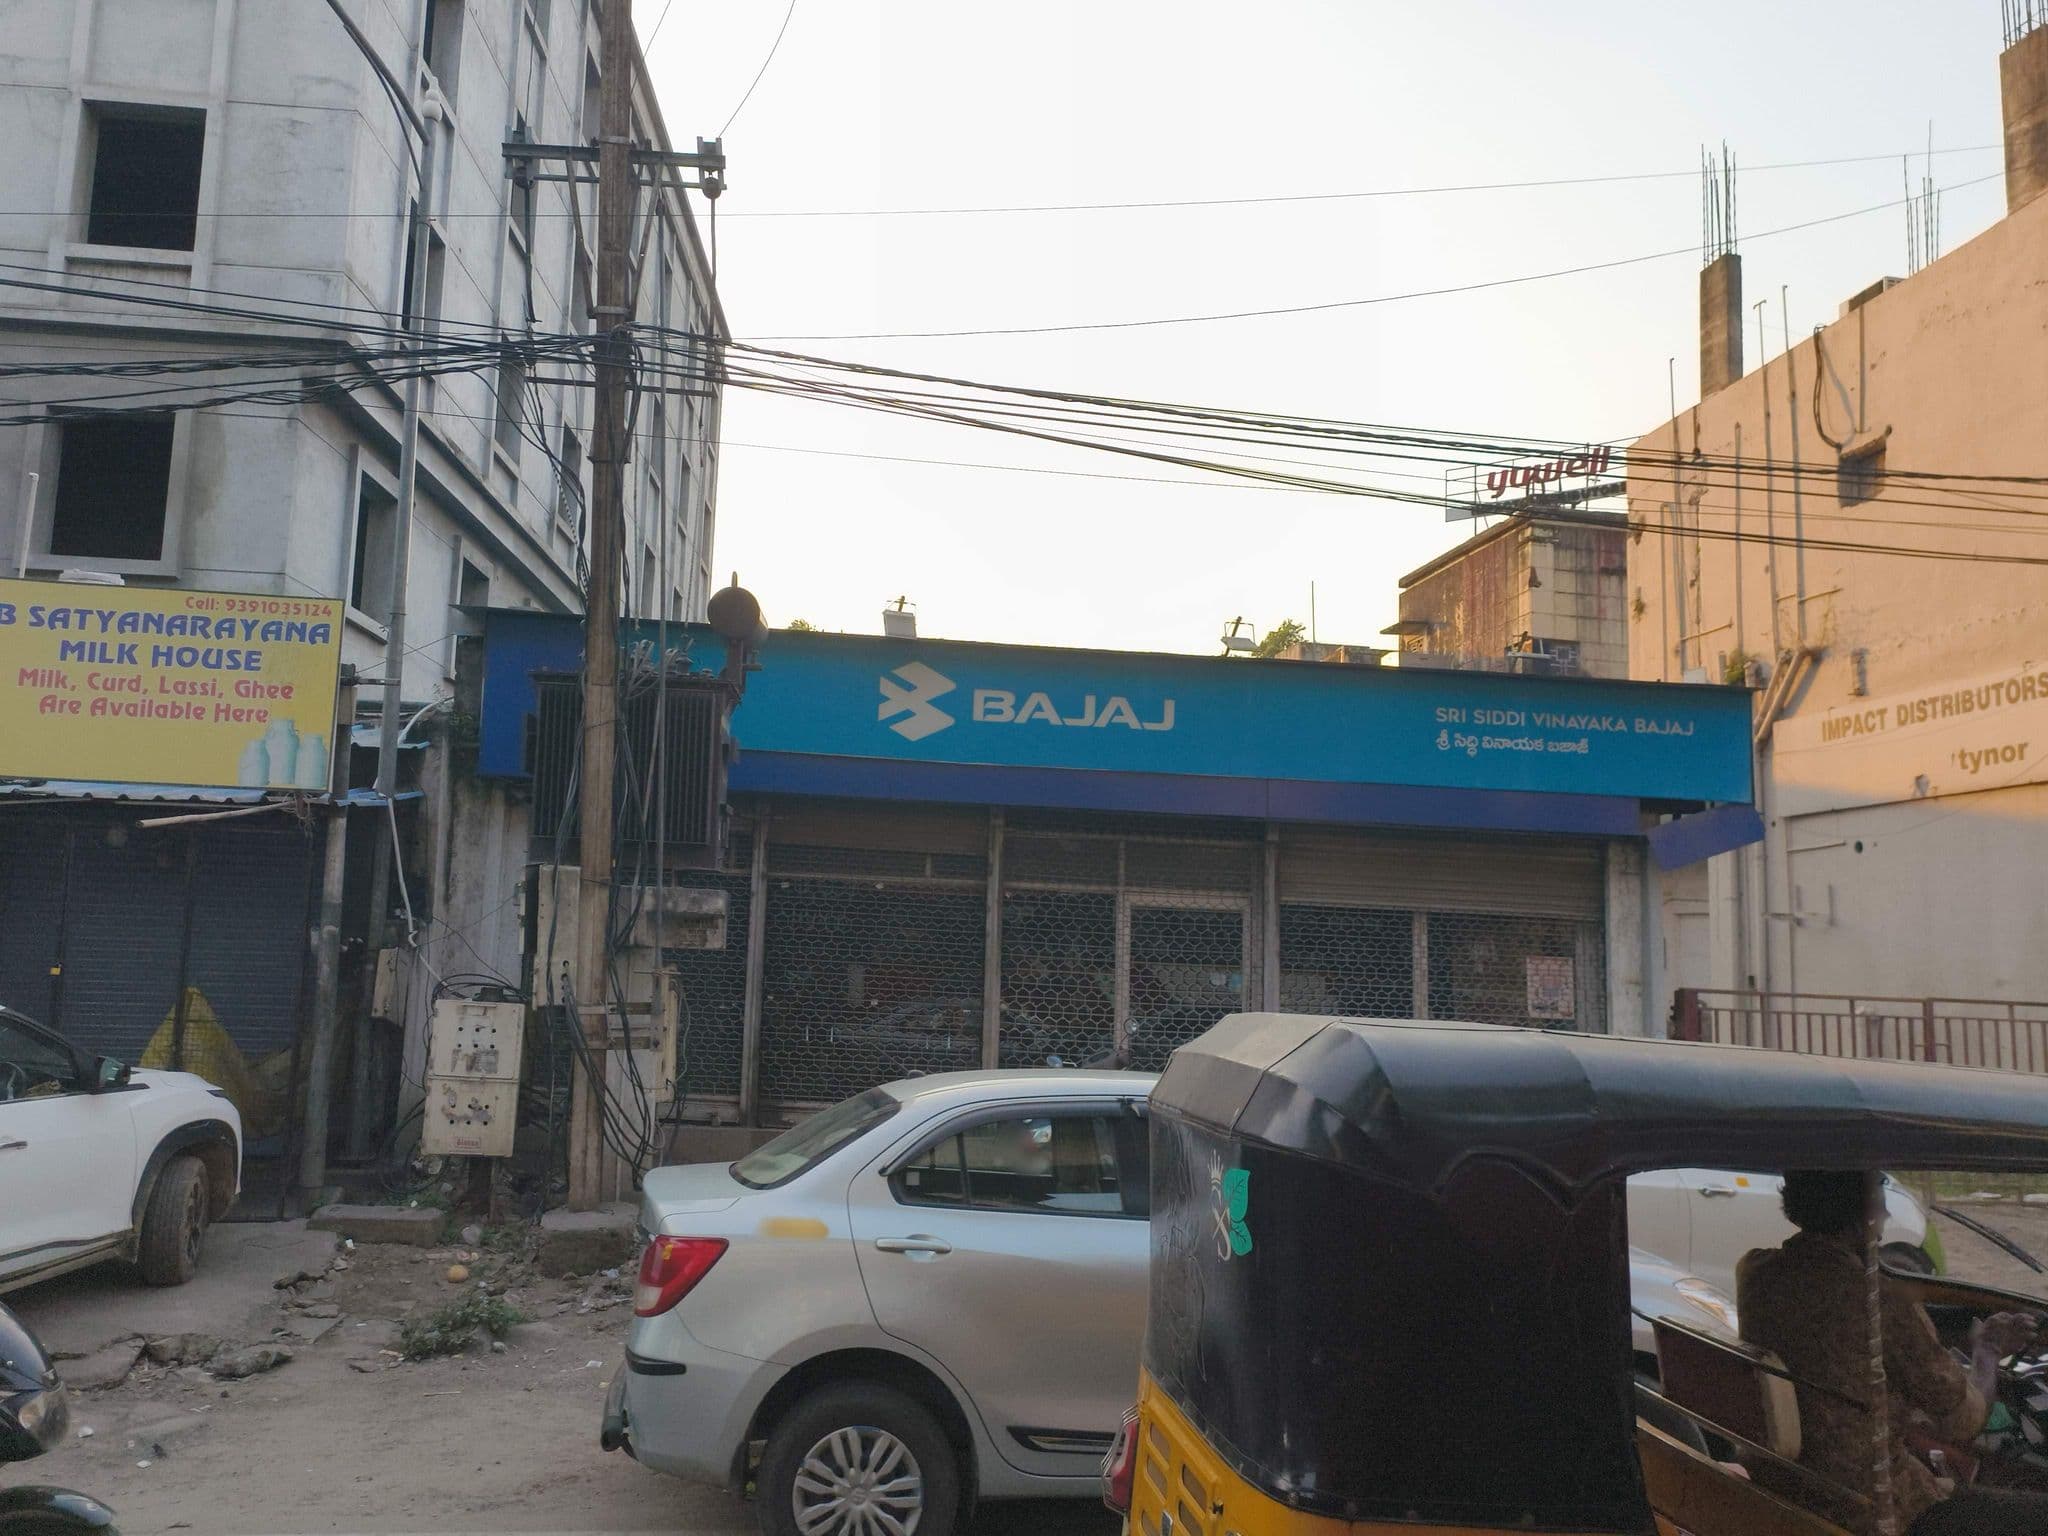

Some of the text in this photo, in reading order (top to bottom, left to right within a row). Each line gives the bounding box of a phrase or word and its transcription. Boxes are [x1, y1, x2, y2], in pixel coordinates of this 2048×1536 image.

[185, 596, 332, 617] Cell: 9391035124
[28, 605, 331, 645] SATYANARAYANA
[59, 639, 262, 671] MILK HOUSE
[18, 667, 294, 700] Milk, Curd, Lassi, Ghee
[39, 694, 269, 723] Are Available Here
[971, 688, 1176, 731] BAJAJ
[1435, 707, 1694, 736] SRI SIDDI VINAYAKA BAJAJ
[1822, 671, 2048, 742] IMPACT DISTRIBUTORS
[1958, 741, 2030, 775] tynor
